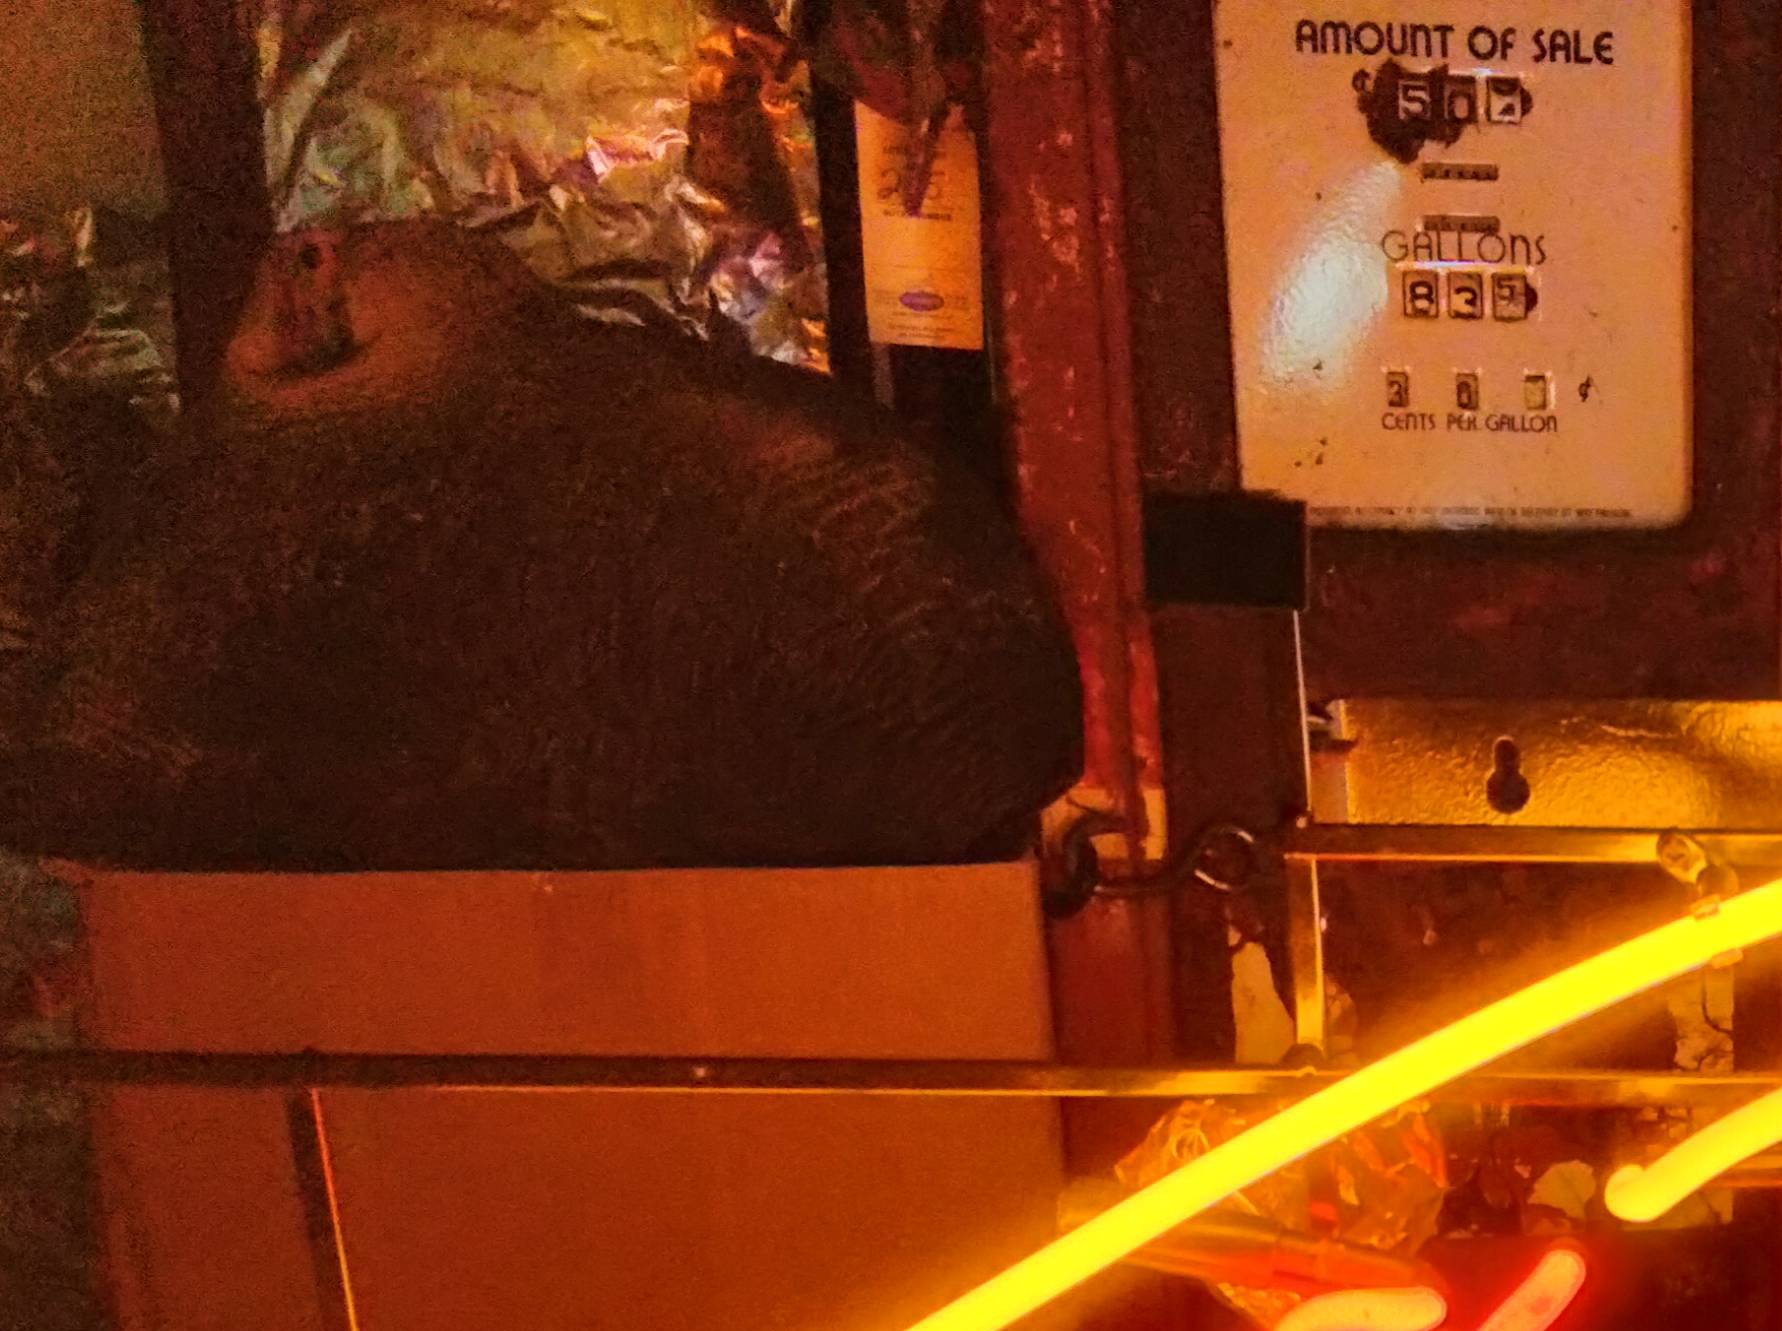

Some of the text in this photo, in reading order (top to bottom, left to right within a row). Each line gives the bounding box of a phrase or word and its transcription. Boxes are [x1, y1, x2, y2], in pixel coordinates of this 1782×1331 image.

[1295, 18, 1615, 65] AMOUNT OF SALE
[1381, 229, 1547, 265] GALLONS
[1381, 412, 1436, 432] CENTS
[1484, 414, 1558, 433] GALLON
